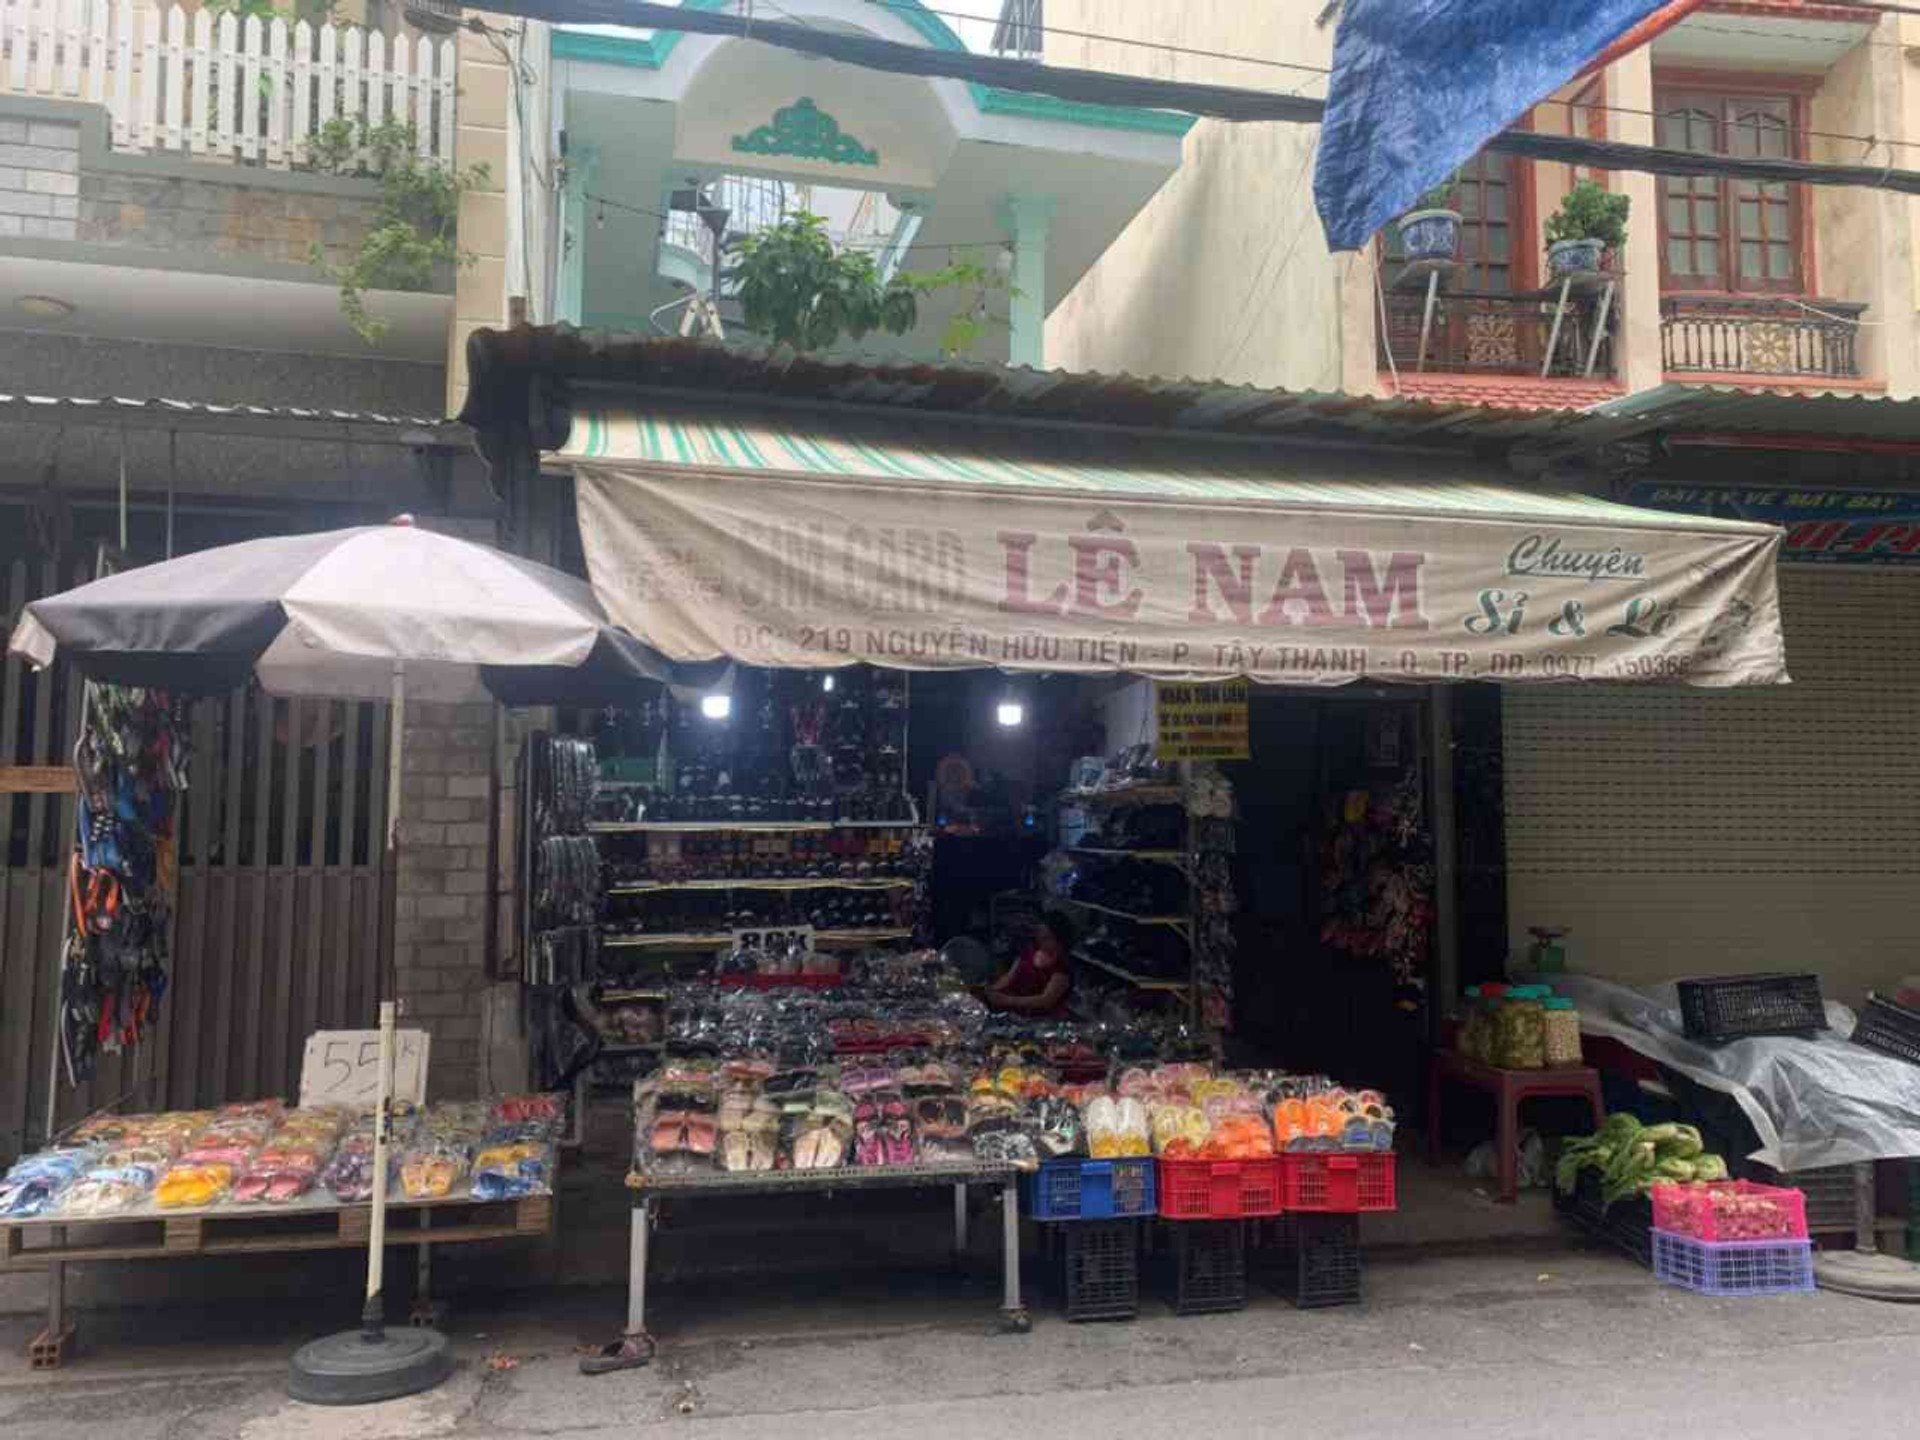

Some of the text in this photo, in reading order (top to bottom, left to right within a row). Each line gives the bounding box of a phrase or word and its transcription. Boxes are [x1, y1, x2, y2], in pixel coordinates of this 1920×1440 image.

[997, 509, 1429, 629] LÊ NAM
[1507, 534, 1646, 582] Chuyên
[1549, 600, 1586, 636] &
[800, 624, 851, 654] 219
[1212, 638, 1265, 668] TÂY
